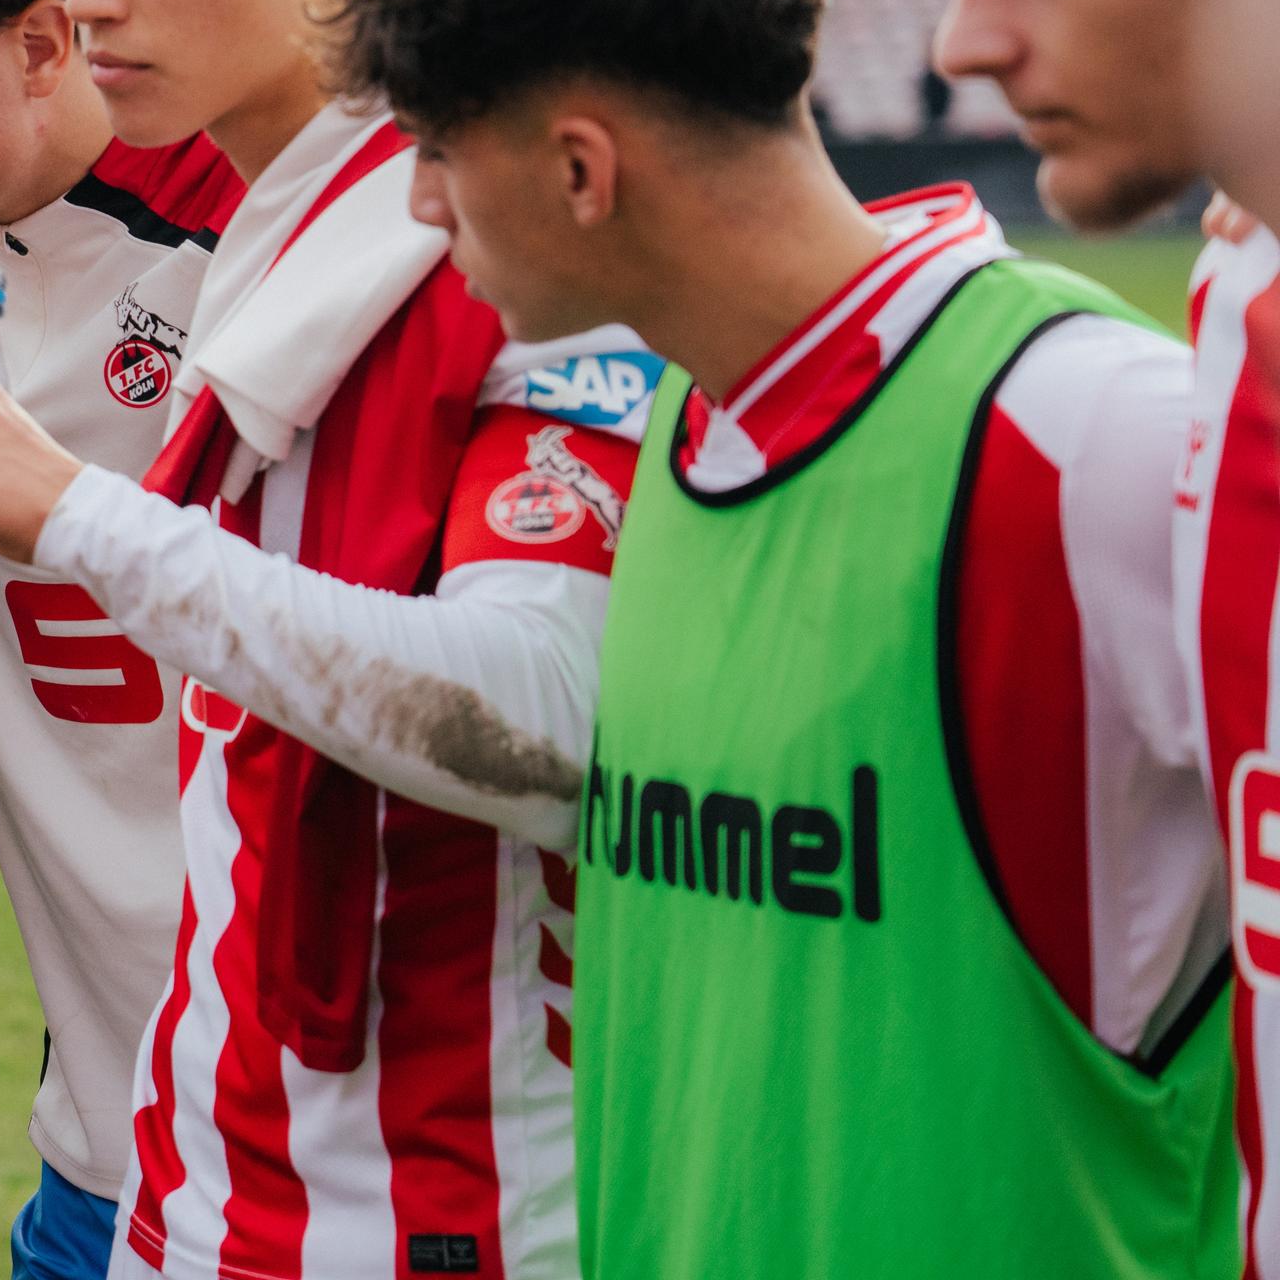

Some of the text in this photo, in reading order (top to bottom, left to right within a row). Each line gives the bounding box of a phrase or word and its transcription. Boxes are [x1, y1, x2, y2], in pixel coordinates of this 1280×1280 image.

[119, 357, 154, 388] 1.FC
[526, 356, 646, 416] SAP
[129, 377, 155, 400] KÖLN
